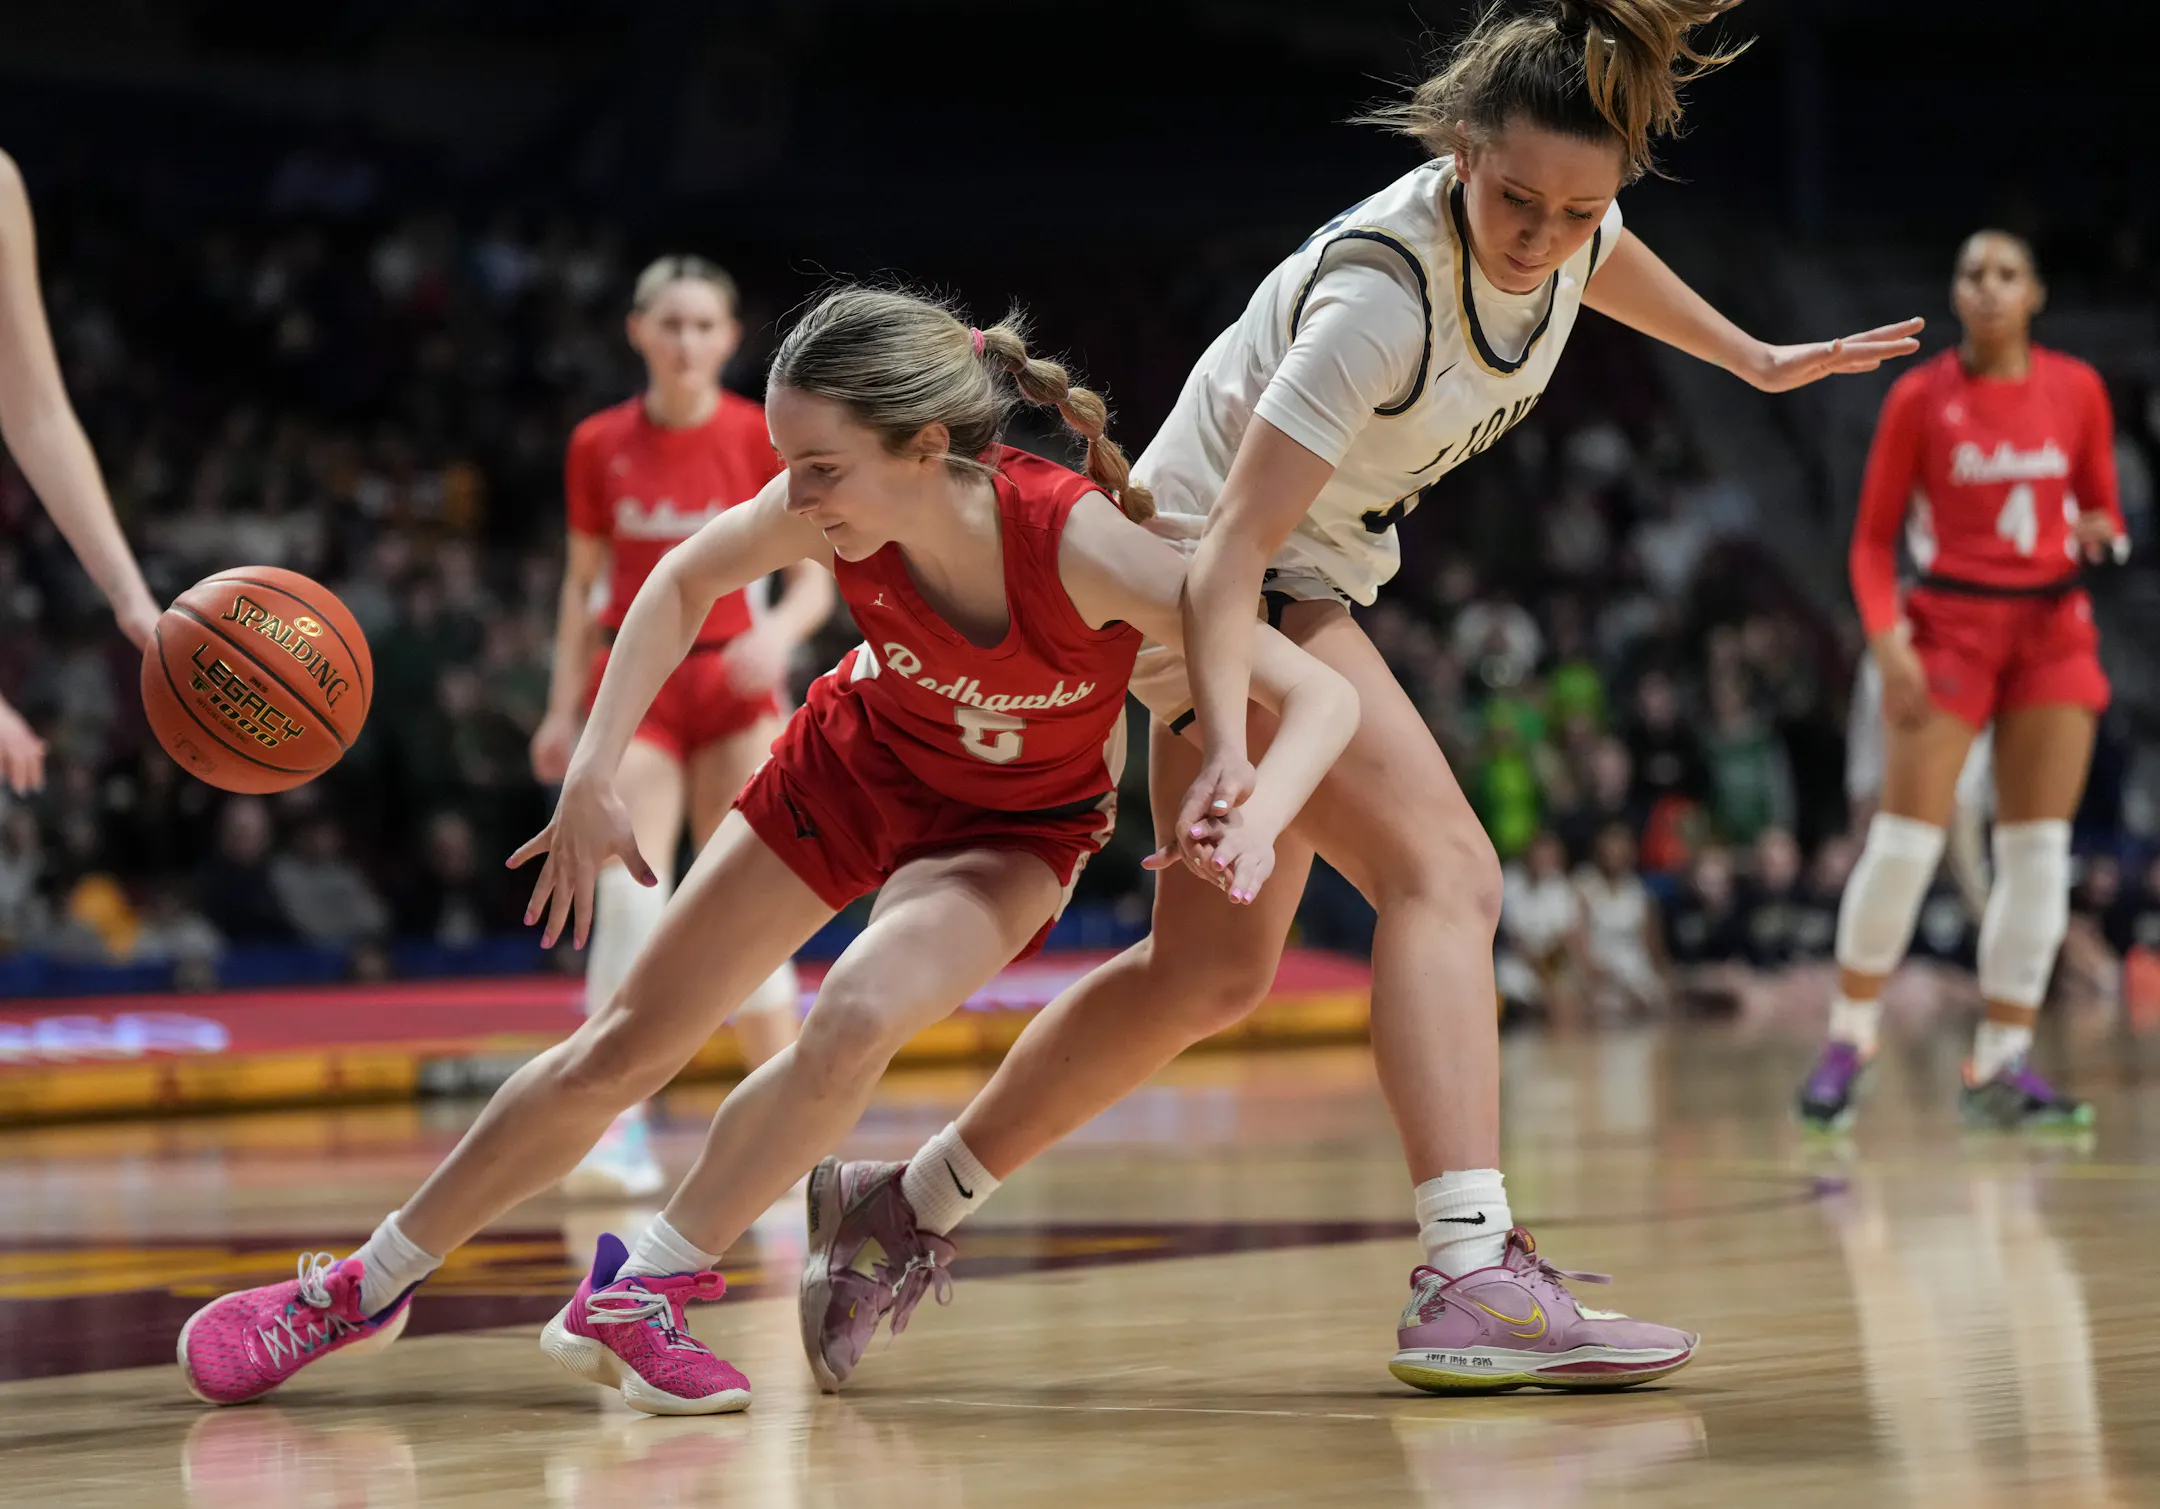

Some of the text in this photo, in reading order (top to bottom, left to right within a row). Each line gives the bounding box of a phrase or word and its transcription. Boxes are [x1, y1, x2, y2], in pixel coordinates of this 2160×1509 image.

[1997, 482, 2038, 557] 4
[191, 643, 305, 741] LEGACY
[221, 595, 349, 708] SPALDING
[1450, 1355, 1467, 1366] into
